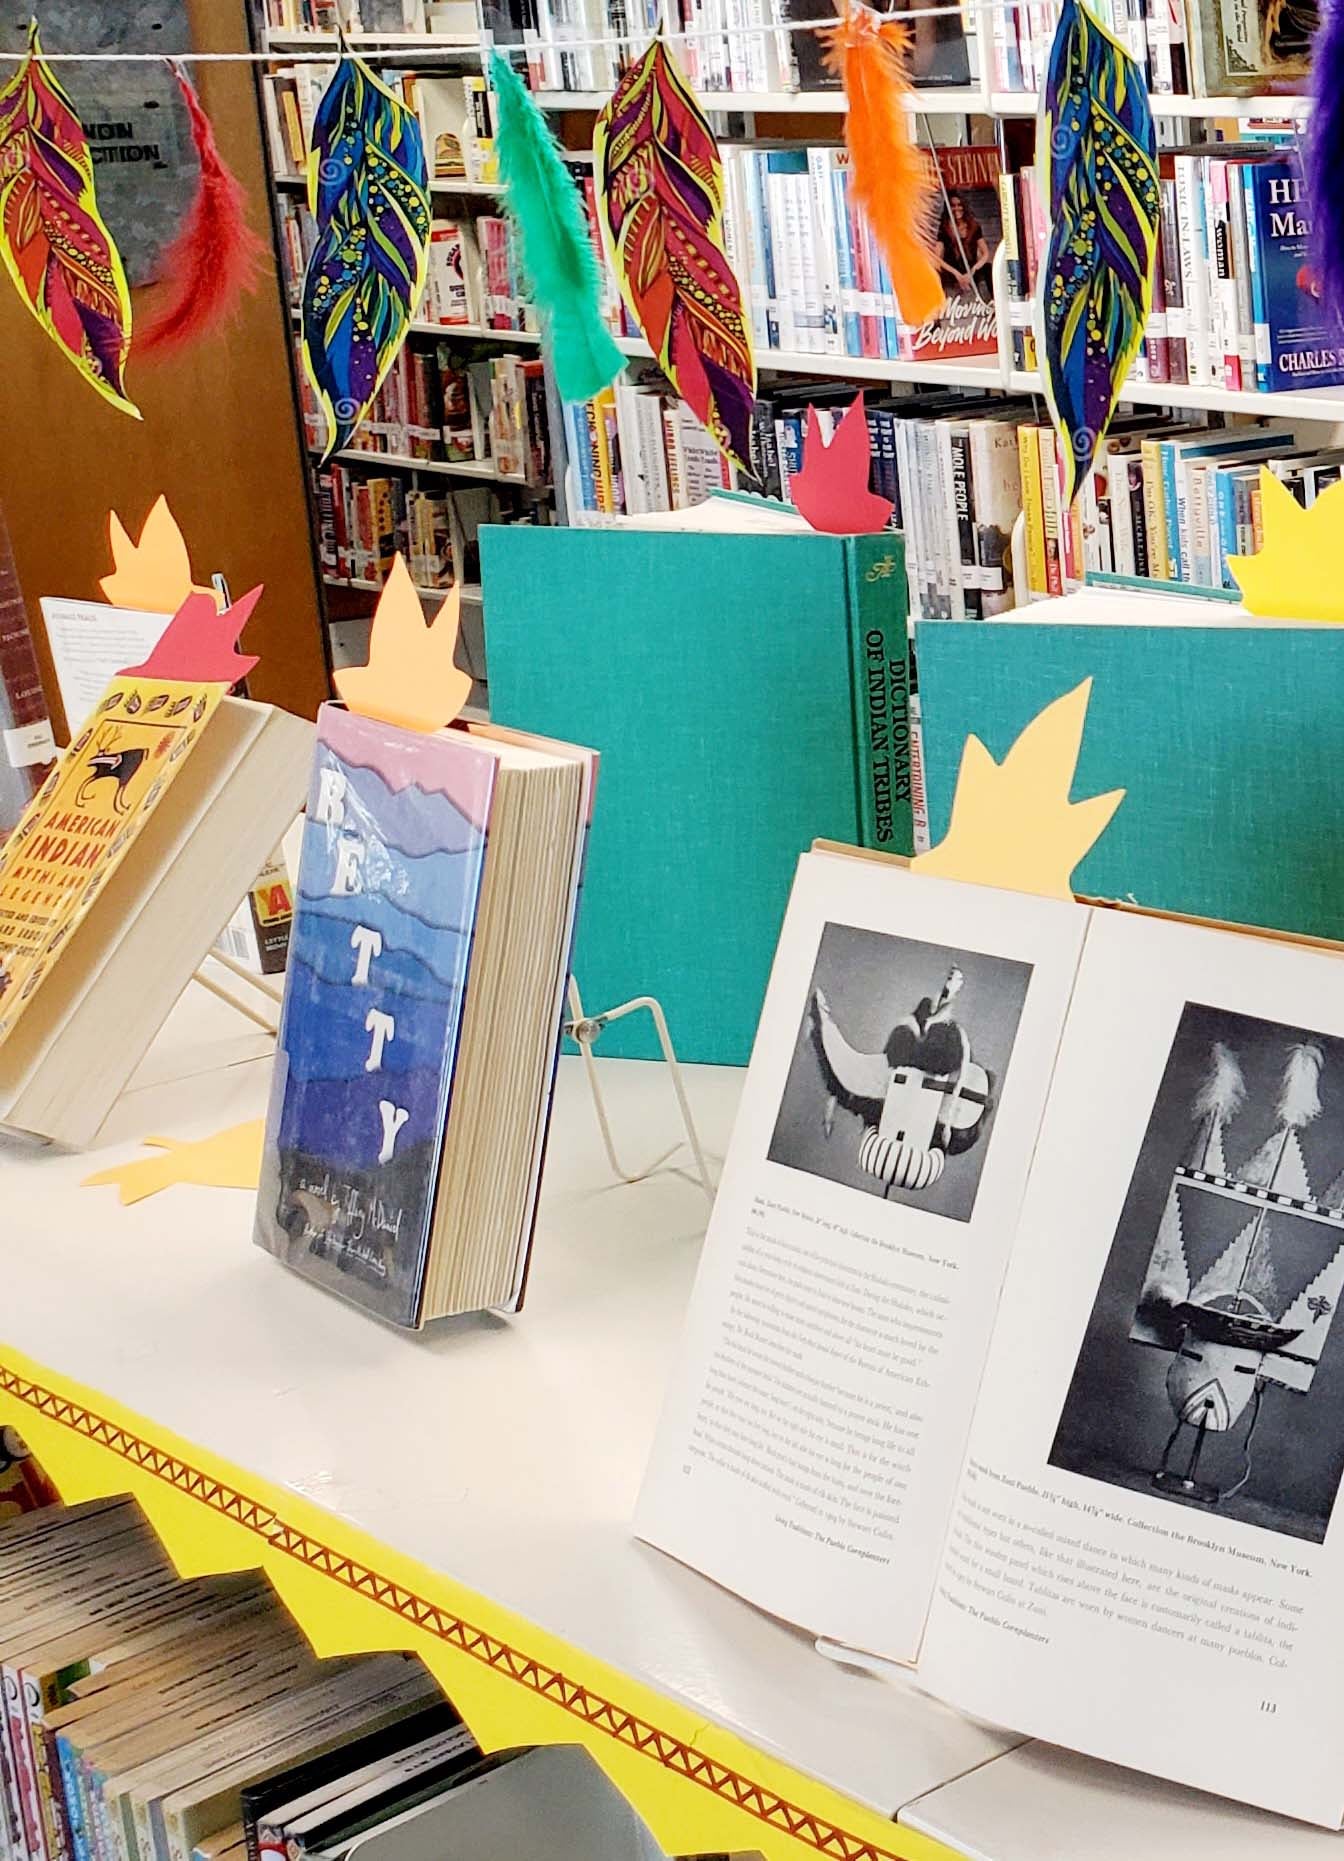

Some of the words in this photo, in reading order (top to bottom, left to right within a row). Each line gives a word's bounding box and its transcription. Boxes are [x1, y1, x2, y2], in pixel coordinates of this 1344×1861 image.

[939, 296, 994, 321] Moving
[912, 317, 975, 352] Beyond
[1279, 348, 1337, 373] CHARLES
[951, 446, 966, 481] MOLE
[953, 481, 968, 521] PEOPLE
[866, 629, 884, 665] OF
[868, 668, 890, 752] INDIAN
[889, 658, 911, 803] DICTIONARY
[872, 755, 894, 843] TRIBES
[44, 812, 120, 838] AMERICAN
[25, 835, 106, 869] INDIAN
[1186, 1532, 1226, 1554] Brooklyn
[1269, 1557, 1289, 1572] New
